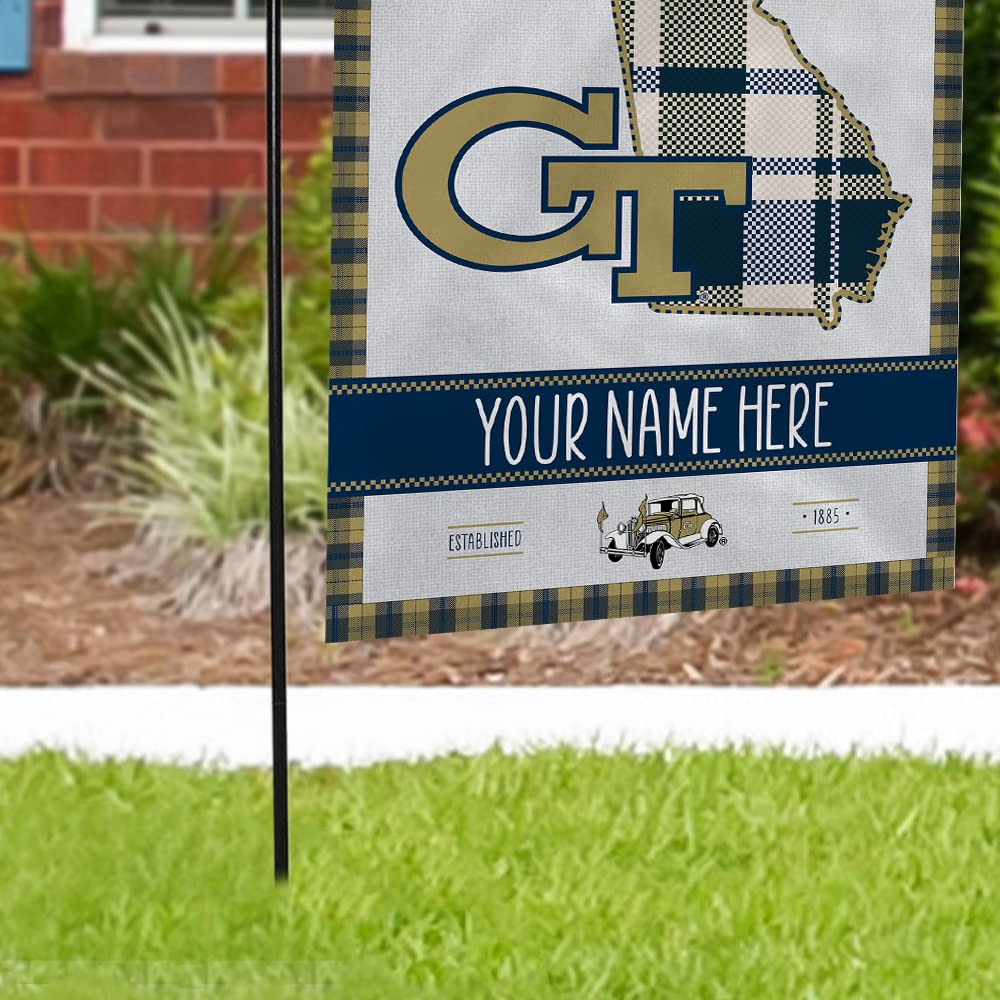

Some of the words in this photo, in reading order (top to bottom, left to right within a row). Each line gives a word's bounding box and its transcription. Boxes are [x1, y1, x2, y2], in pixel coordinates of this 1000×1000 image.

[395, 86, 752, 304] GT
[476, 393, 589, 467] YOUR
[606, 386, 723, 459] NAME
[738, 382, 834, 452] HERE
[448, 528, 523, 553] ESTABLISHED
[812, 507, 840, 526] 1885
